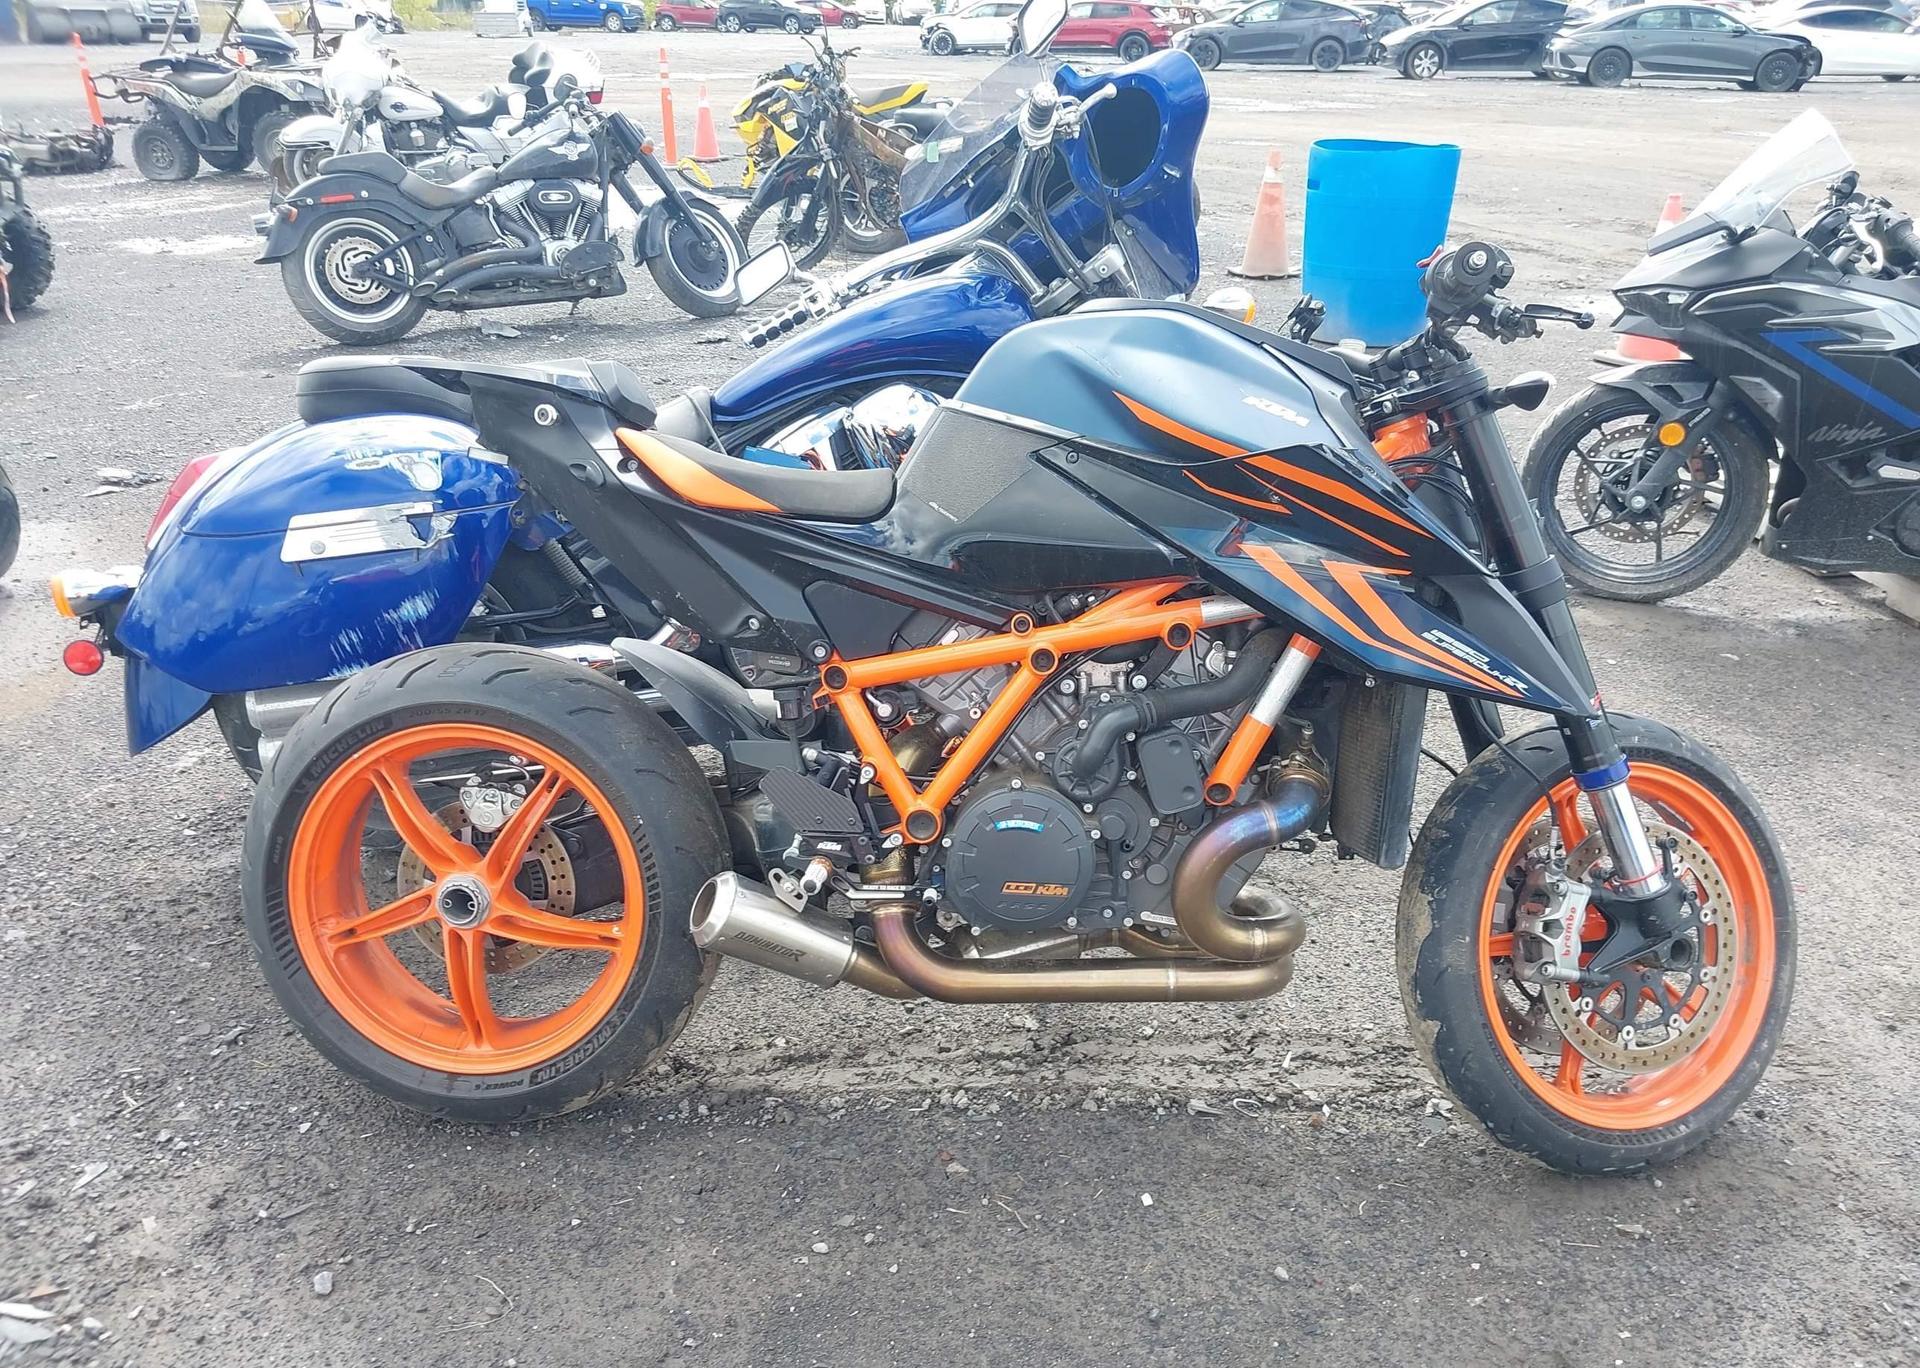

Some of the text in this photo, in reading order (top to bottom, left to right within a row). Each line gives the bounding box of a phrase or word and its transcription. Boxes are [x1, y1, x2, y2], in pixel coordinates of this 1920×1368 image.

[1807, 421, 1887, 448] Ninja
[311, 717, 387, 779] MICHELIN
[734, 930, 808, 962] DOMINATOR
[1561, 906, 1577, 957] brembo
[537, 1025, 612, 1082] MICHELIN
